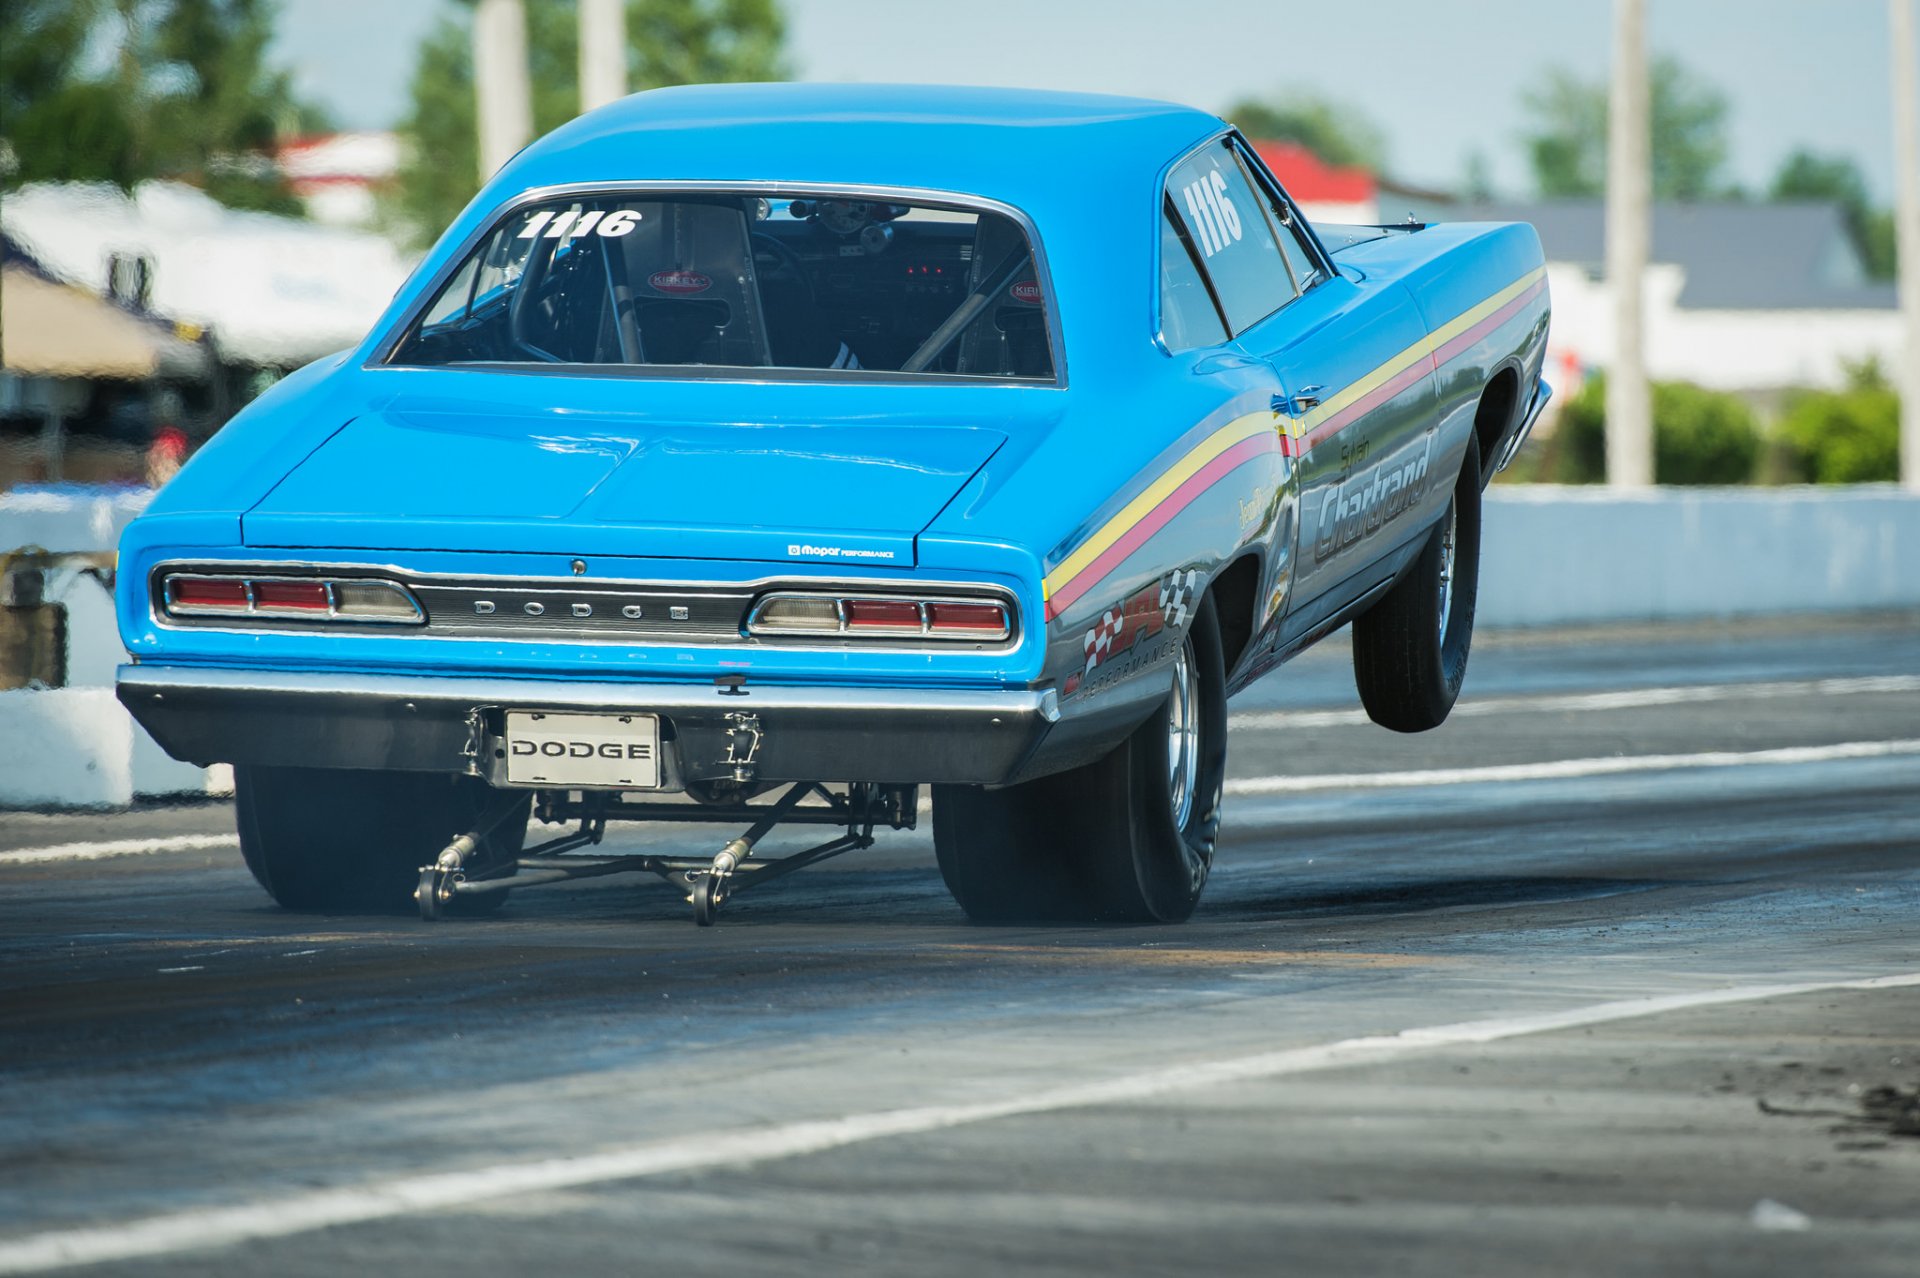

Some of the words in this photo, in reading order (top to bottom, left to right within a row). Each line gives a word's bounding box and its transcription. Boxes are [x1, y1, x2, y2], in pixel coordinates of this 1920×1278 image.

[516, 209, 643, 239] 1116
[1183, 169, 1243, 258] 1116
[654, 275, 698, 286] KIRKEY
[1315, 430, 1433, 563] Chartrand
[841, 550, 894, 559] PERFORMANCE
[474, 600, 689, 620] DODGE
[1082, 636, 1178, 702] PERFORMANCE
[512, 740, 651, 759] DODGE
